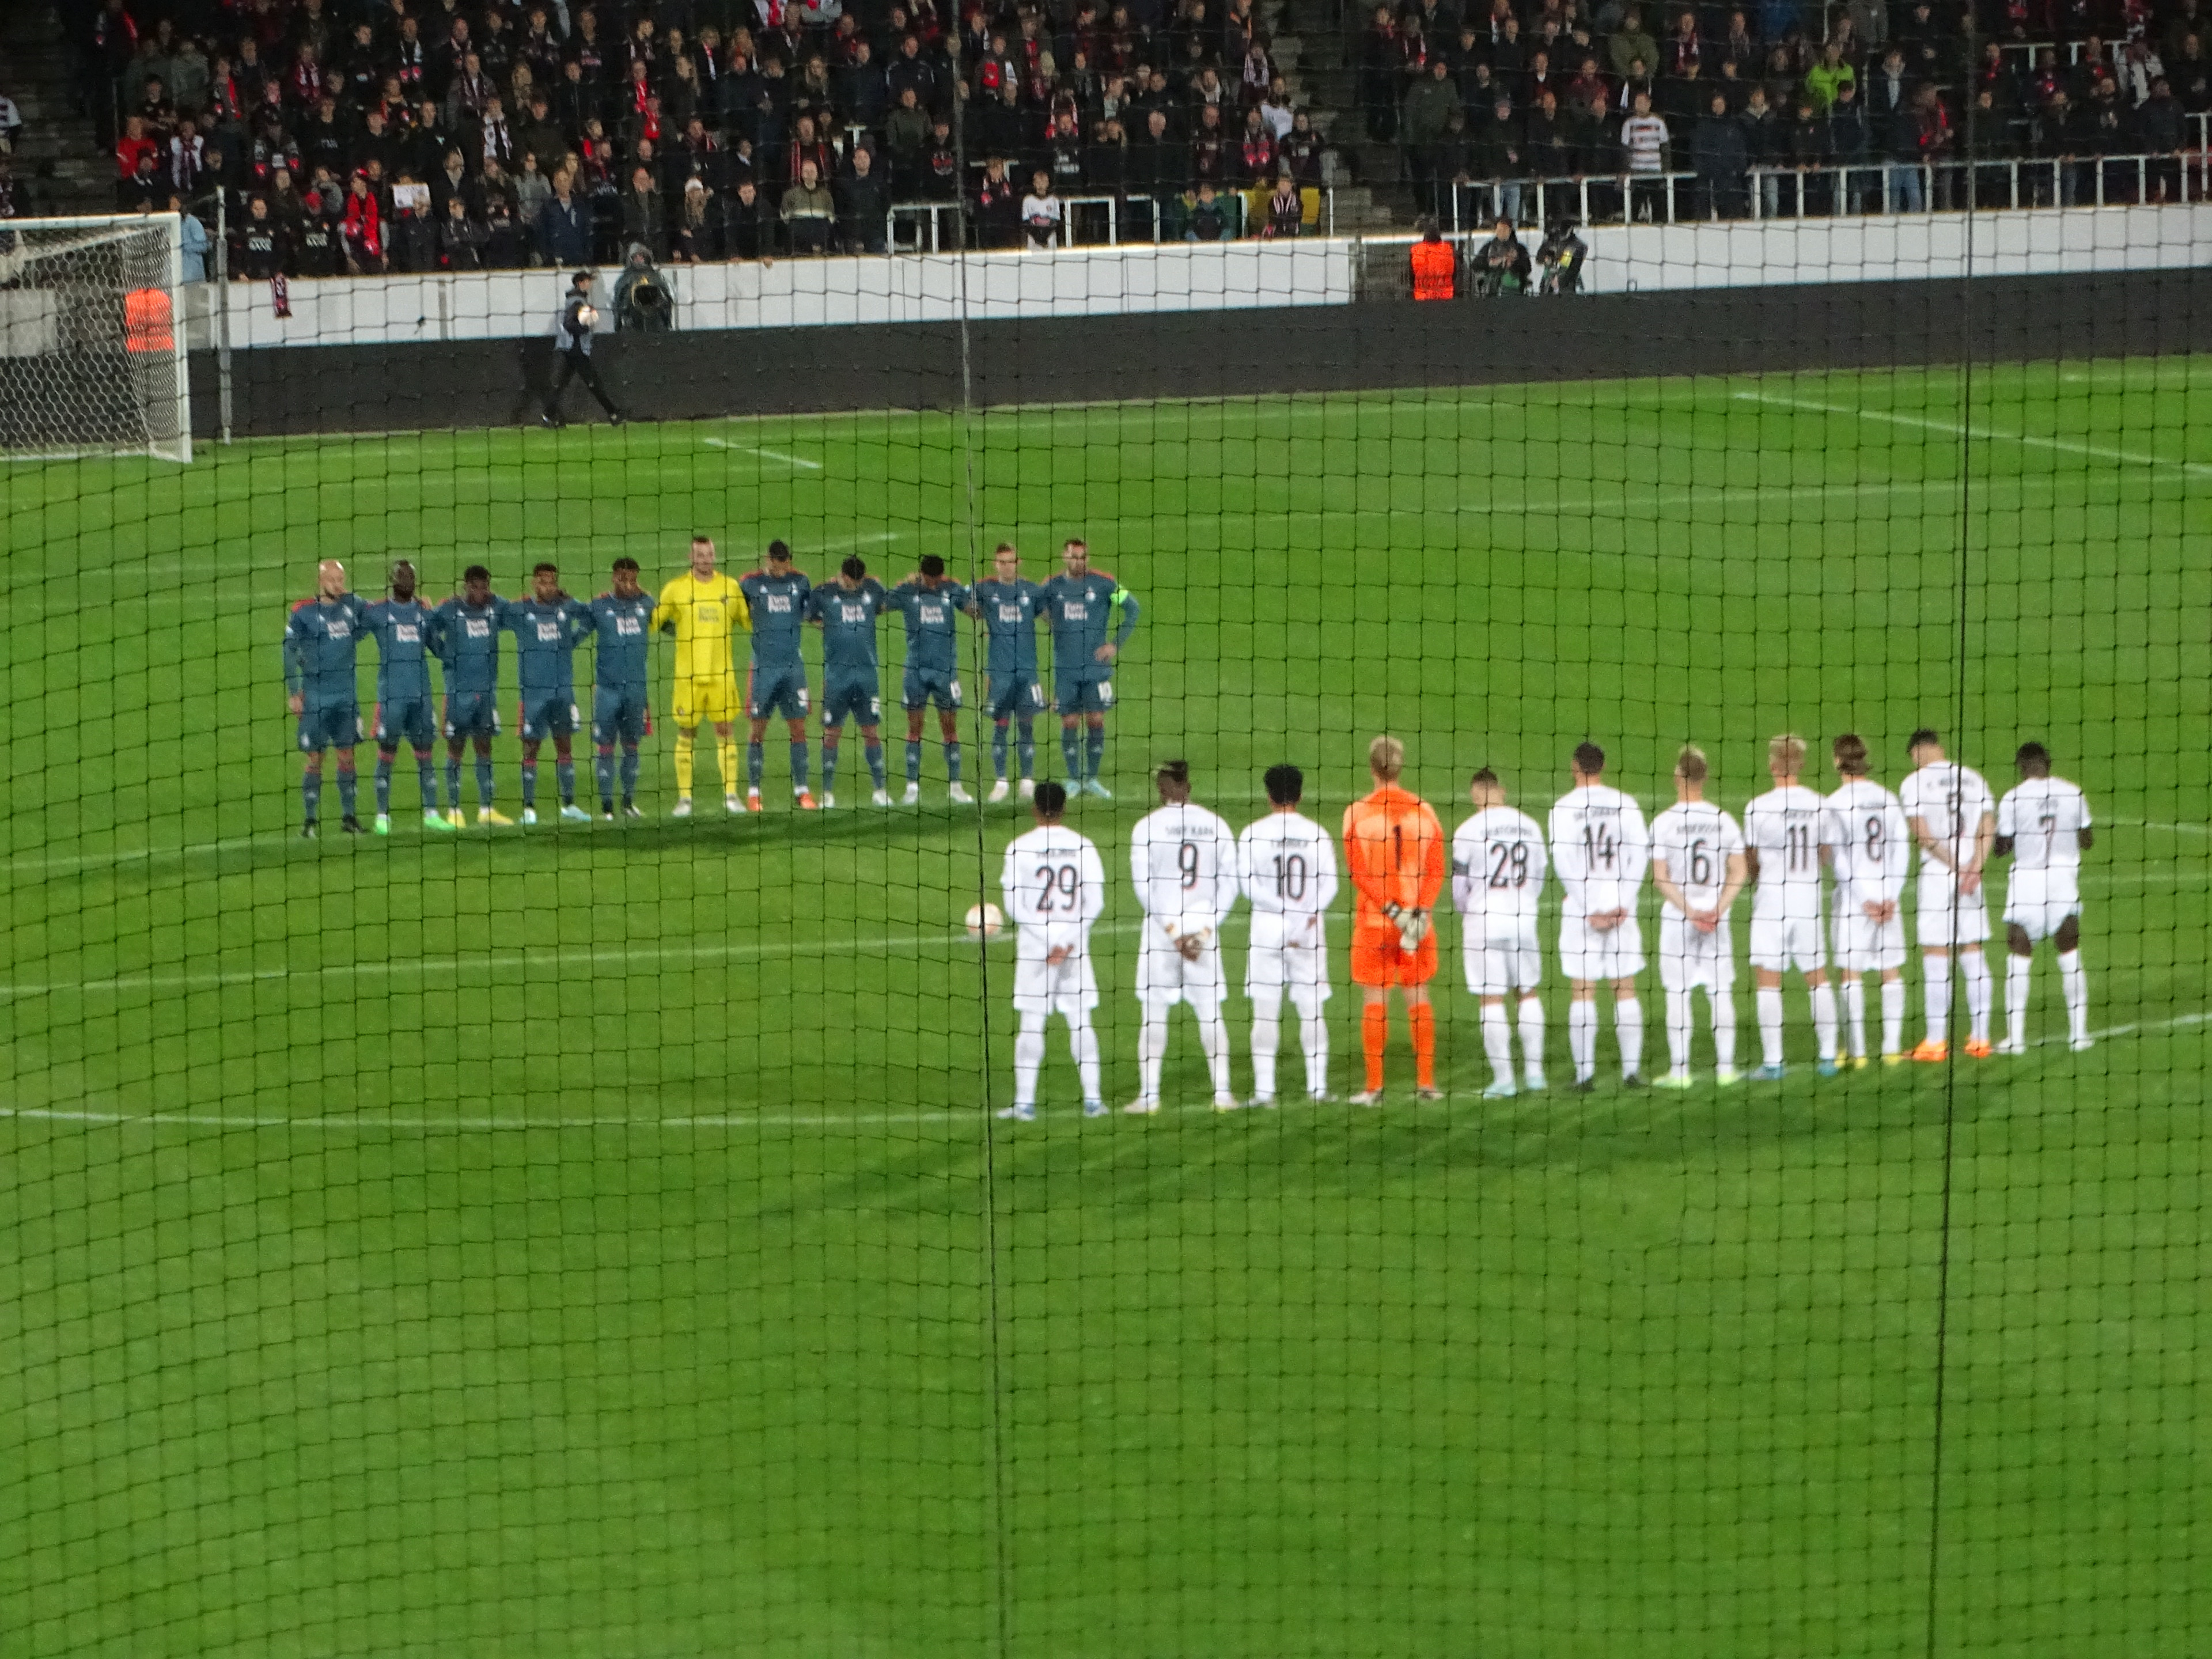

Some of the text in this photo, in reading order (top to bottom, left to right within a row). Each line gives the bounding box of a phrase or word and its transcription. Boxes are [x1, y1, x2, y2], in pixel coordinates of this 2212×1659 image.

[1392, 825, 1402, 871] 1
[1582, 822, 1615, 870] 14
[1789, 823, 1808, 872] 11
[1866, 816, 1883, 862] 8
[2038, 813, 2056, 861] 7
[1179, 843, 1199, 890] 9
[1272, 854, 1306, 901] 10
[1490, 842, 1528, 888] 28
[1691, 838, 1710, 885] 6
[1036, 865, 1077, 911] 29
